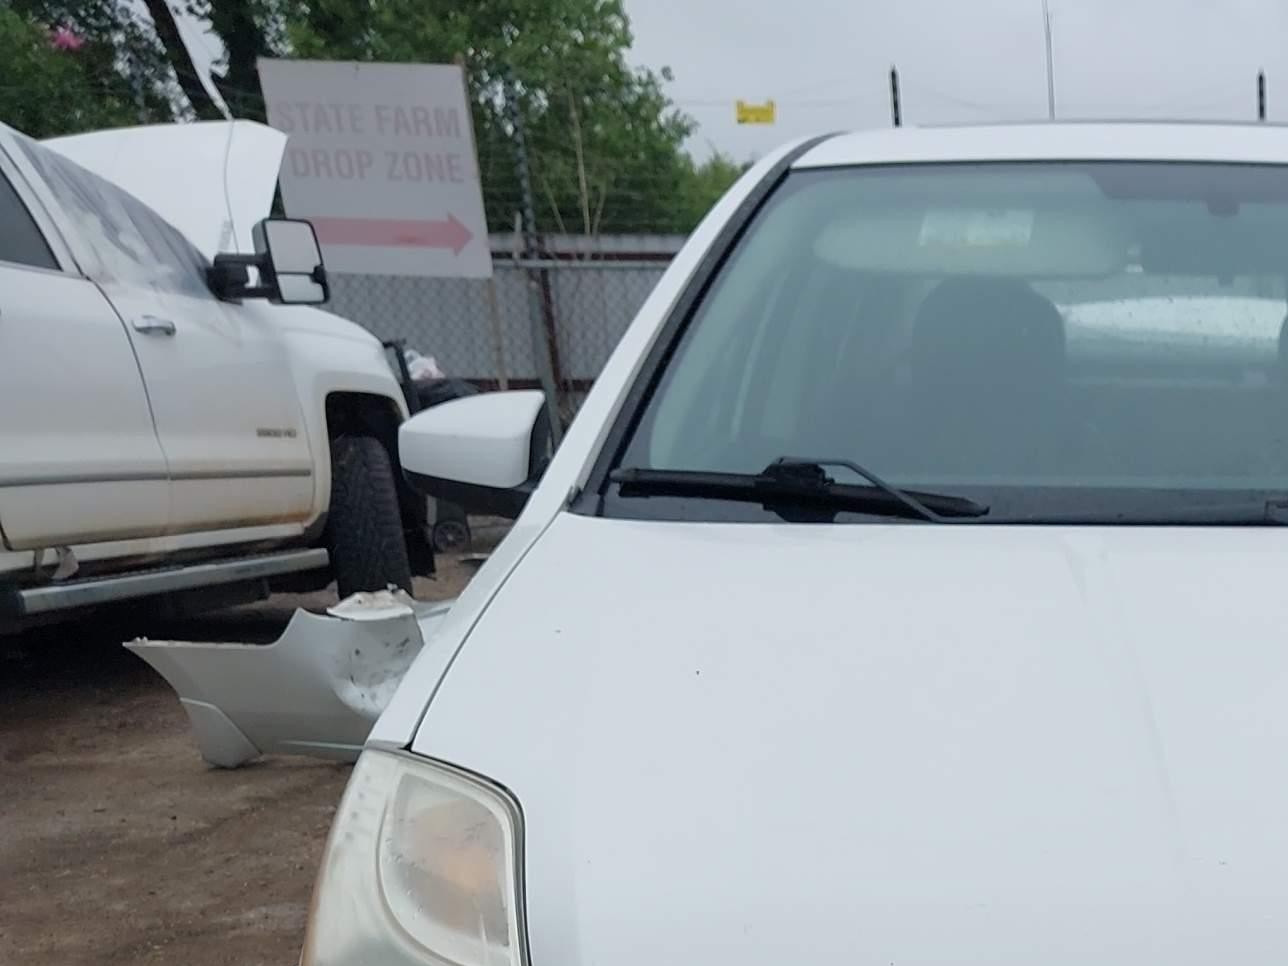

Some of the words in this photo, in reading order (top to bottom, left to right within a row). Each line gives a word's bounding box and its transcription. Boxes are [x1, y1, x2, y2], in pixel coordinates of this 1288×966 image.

[278, 102, 367, 134] STATE
[375, 104, 461, 139] FARM
[289, 148, 374, 181] DROP
[386, 151, 465, 184] ZONE
